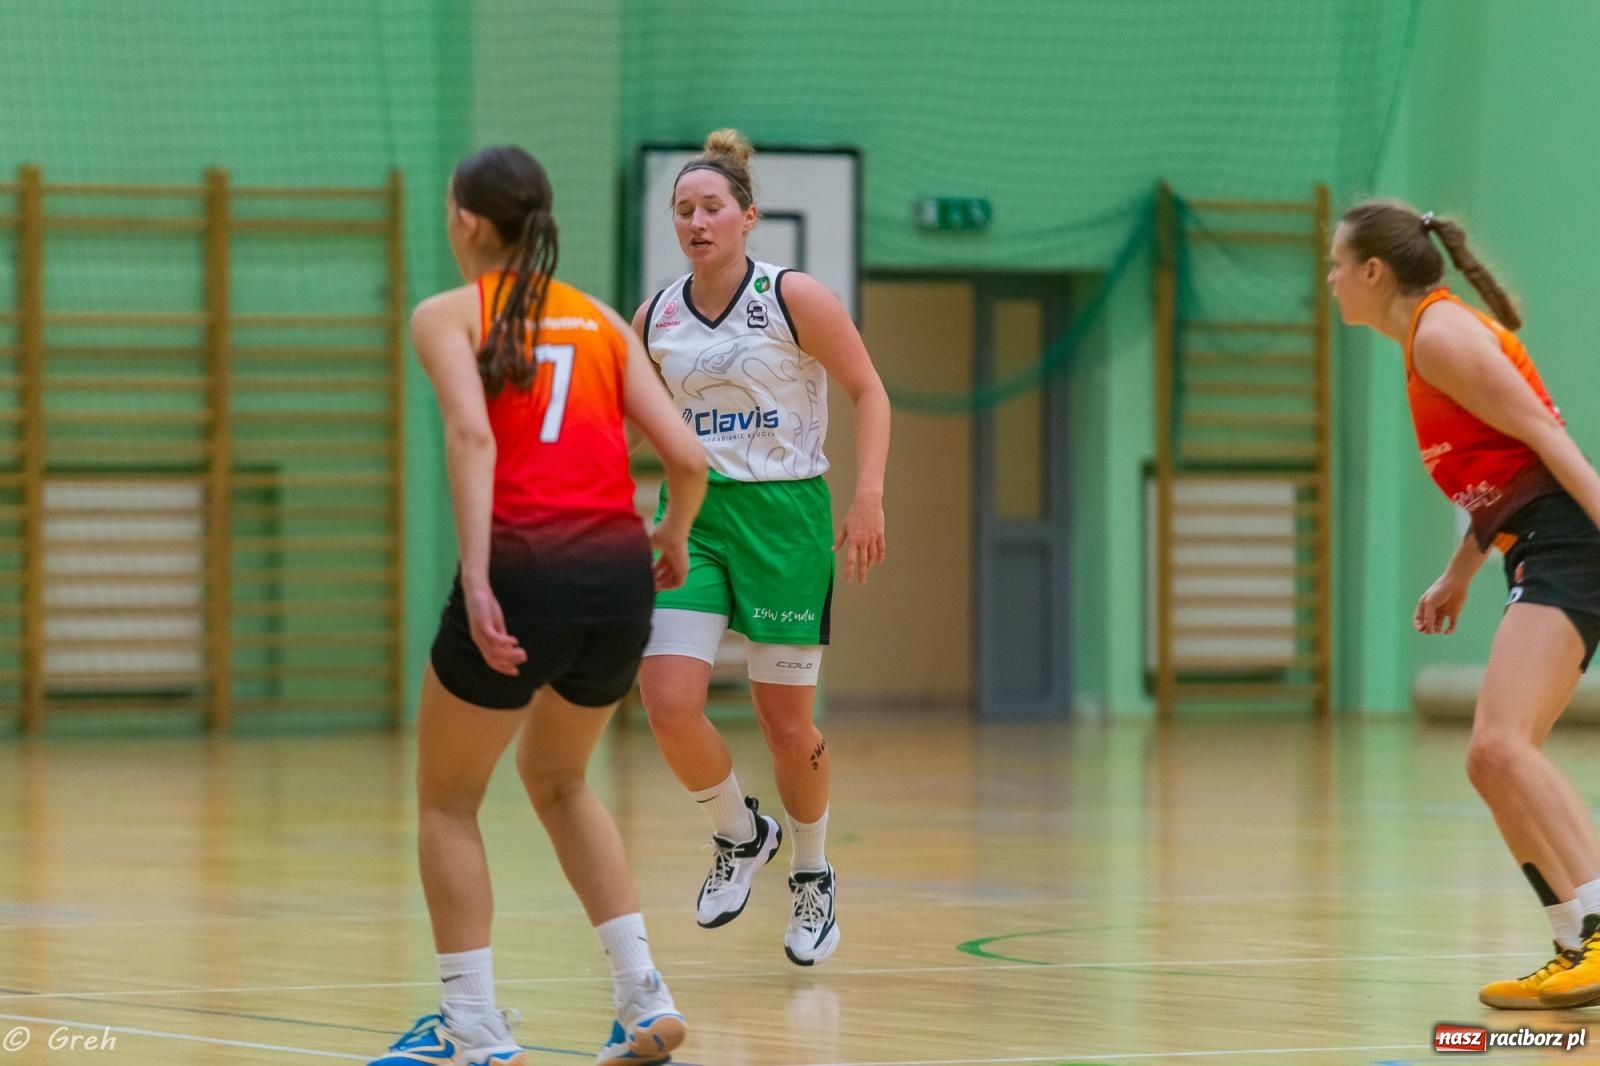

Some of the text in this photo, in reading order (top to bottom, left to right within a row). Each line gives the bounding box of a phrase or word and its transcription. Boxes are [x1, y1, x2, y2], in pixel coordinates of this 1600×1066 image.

[747, 301, 769, 328] 3
[534, 344, 574, 443] 7
[695, 407, 779, 436] Clavis
